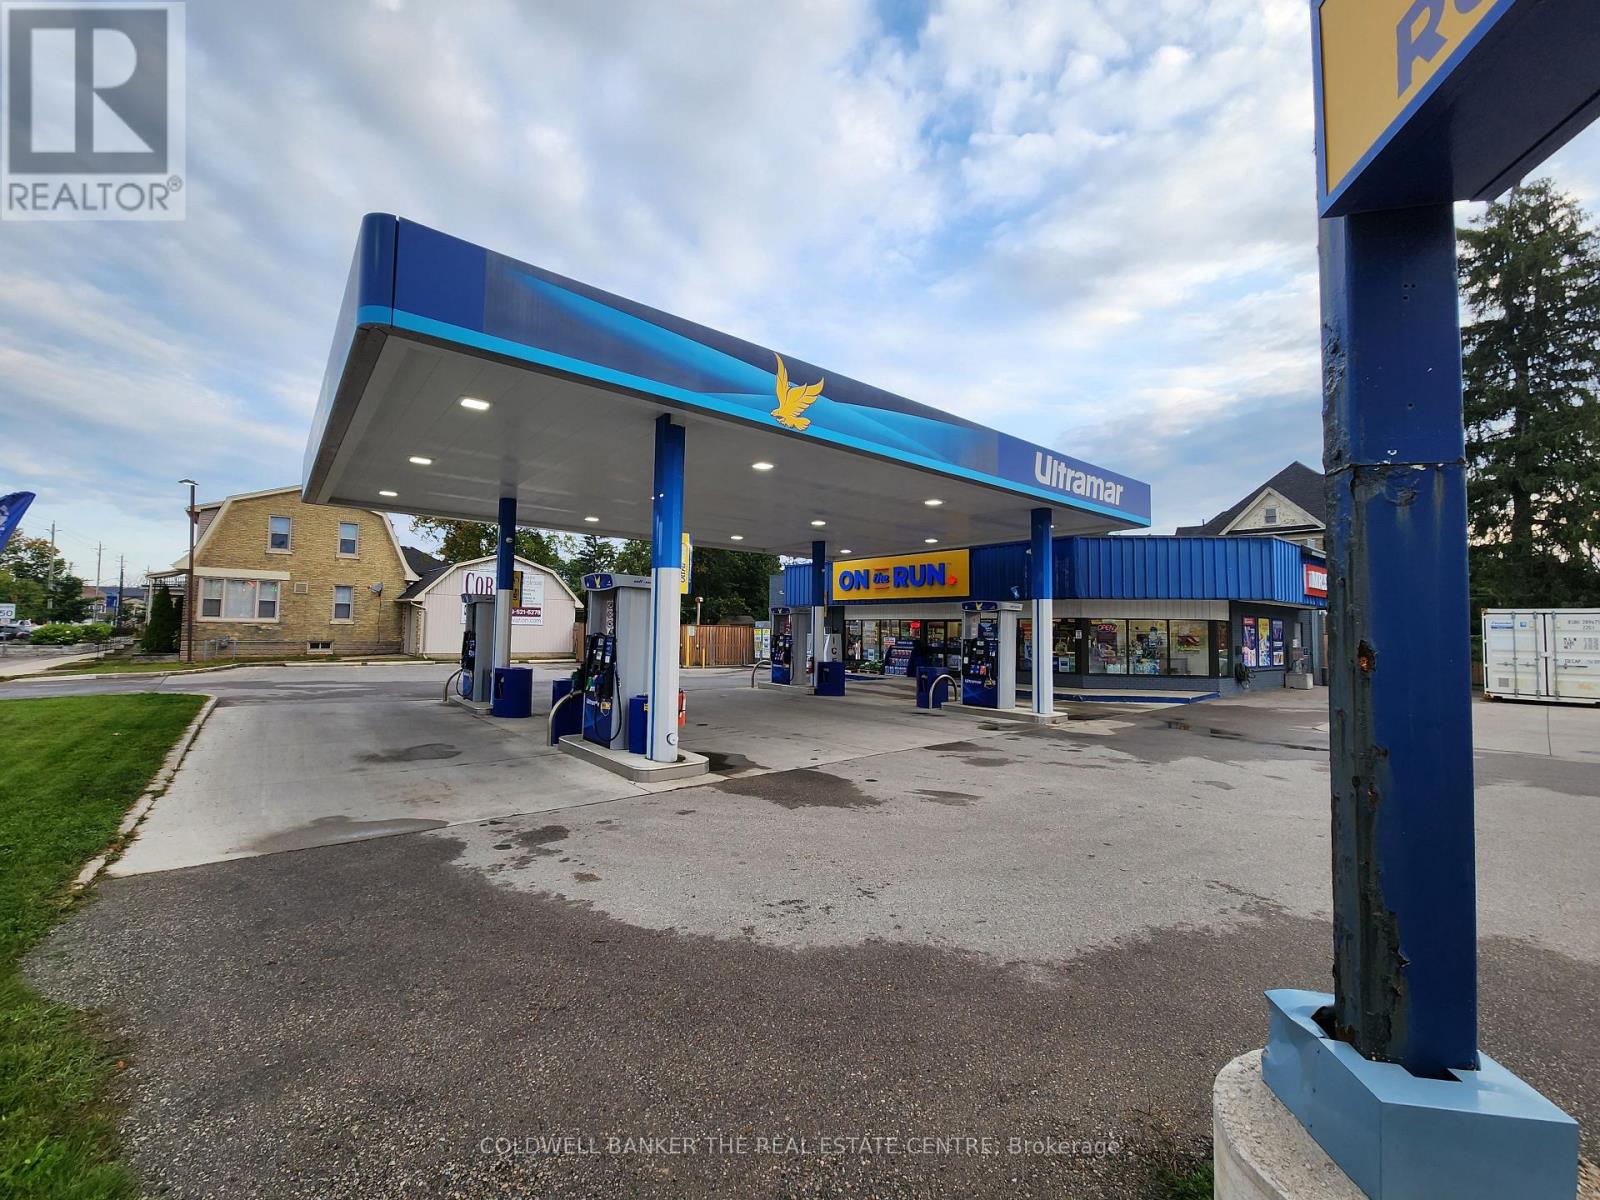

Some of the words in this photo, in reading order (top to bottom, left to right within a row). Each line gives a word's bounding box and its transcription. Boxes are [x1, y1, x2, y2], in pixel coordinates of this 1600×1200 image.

[1034, 451, 1124, 506] Ultramar
[838, 569, 870, 591] ON
[872, 570, 890, 586] the
[1098, 624, 1117, 632] OPEN
